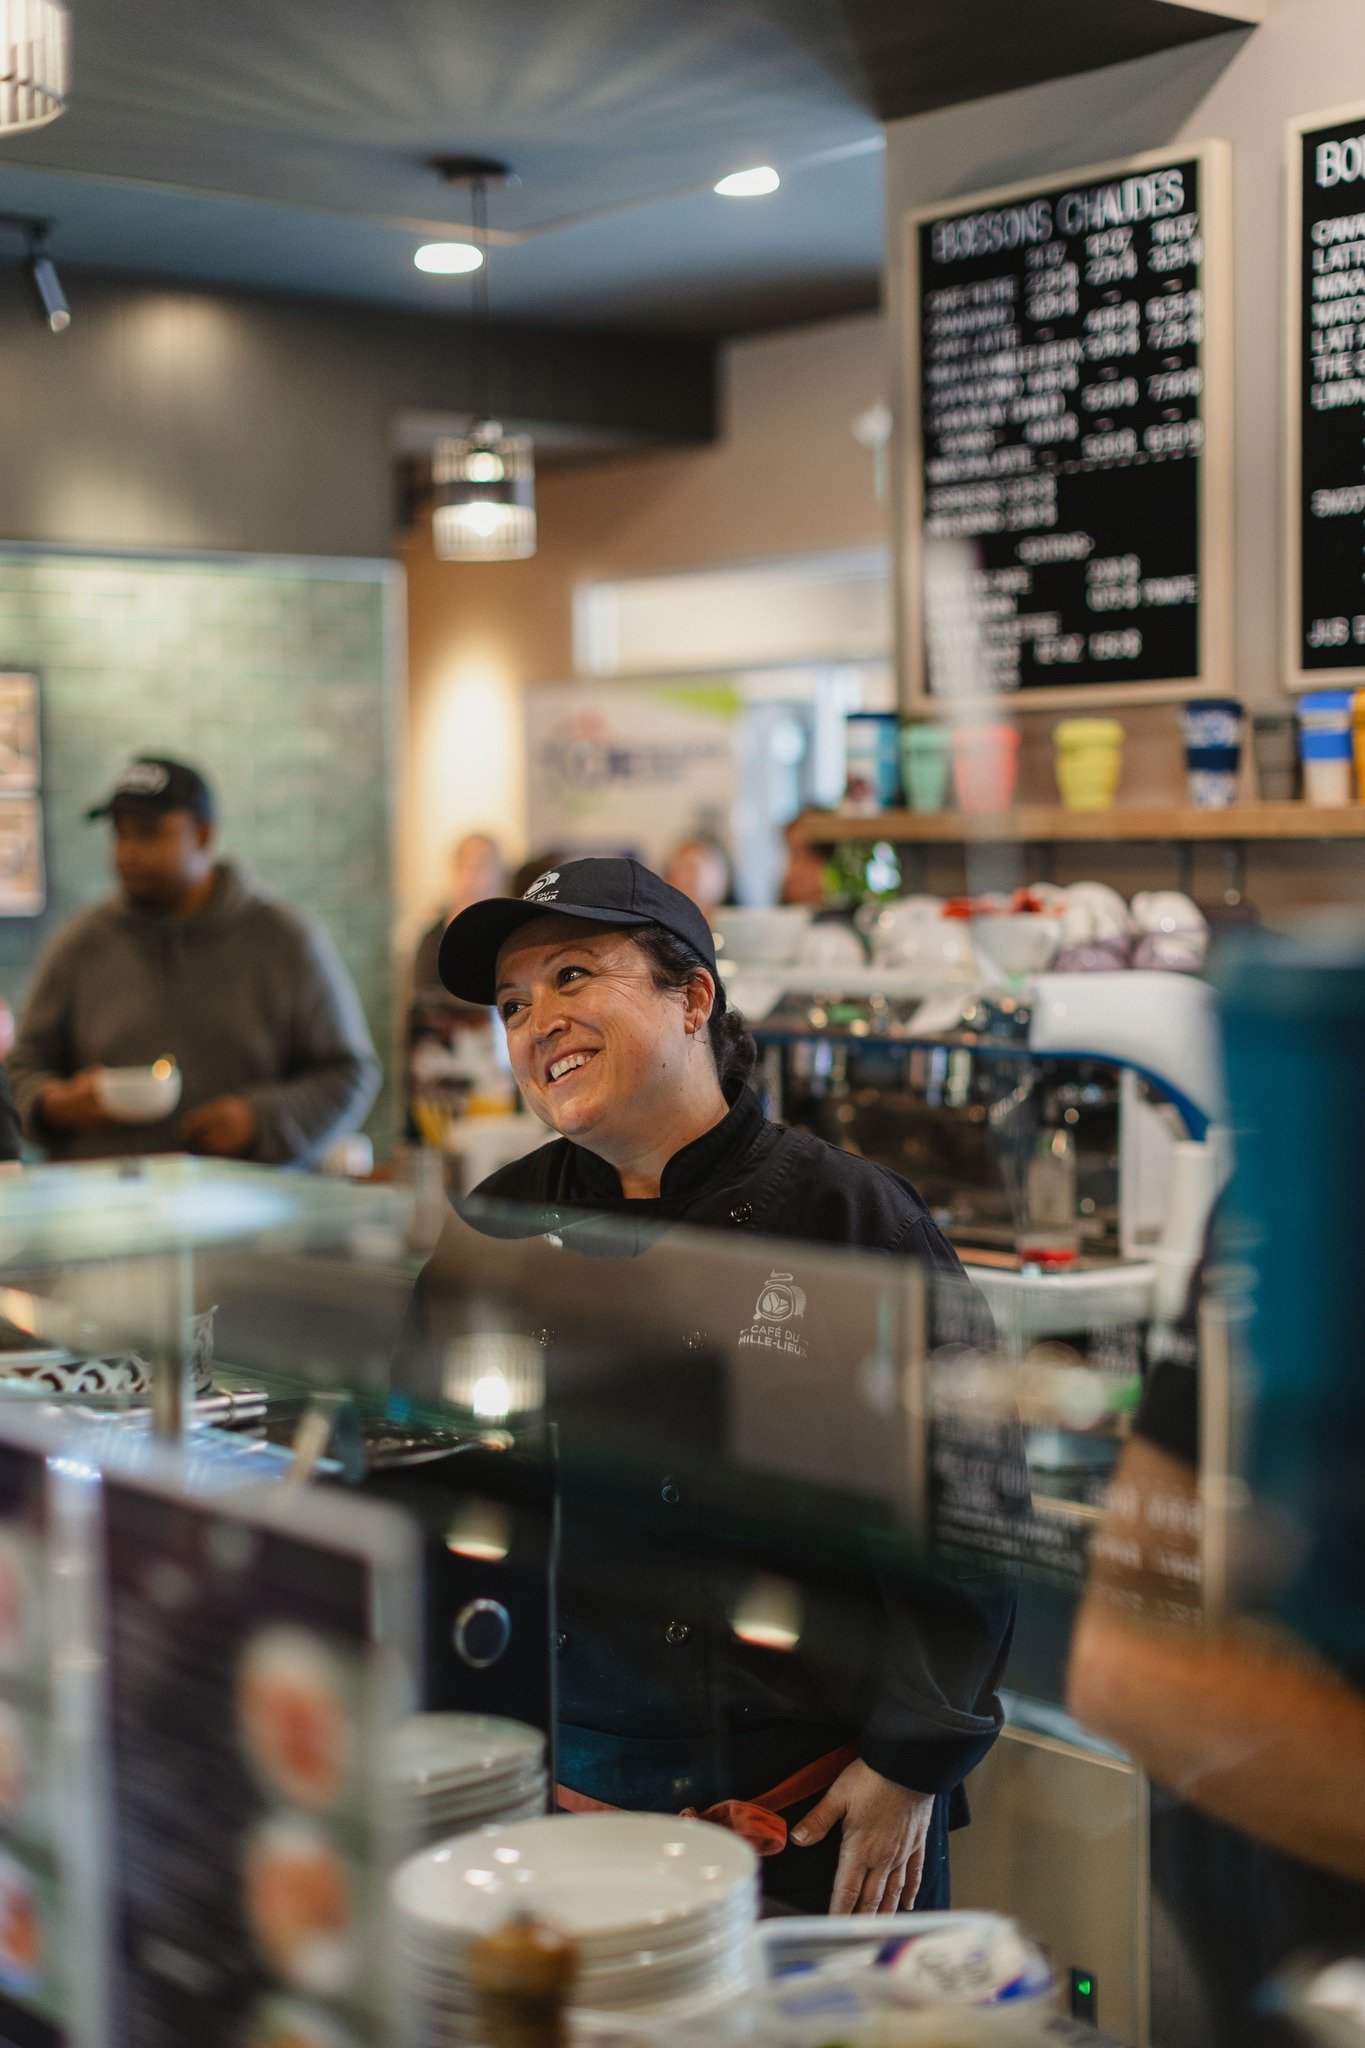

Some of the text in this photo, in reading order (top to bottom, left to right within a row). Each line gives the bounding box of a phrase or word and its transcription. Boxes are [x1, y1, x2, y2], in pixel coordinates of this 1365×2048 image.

[931, 199, 1053, 264] BOISSONS
[1056, 169, 1184, 236] CHAUDES
[751, 1325, 800, 1342] CAFÉ DU
[738, 1335, 807, 1358] MILLE-LIEUX
